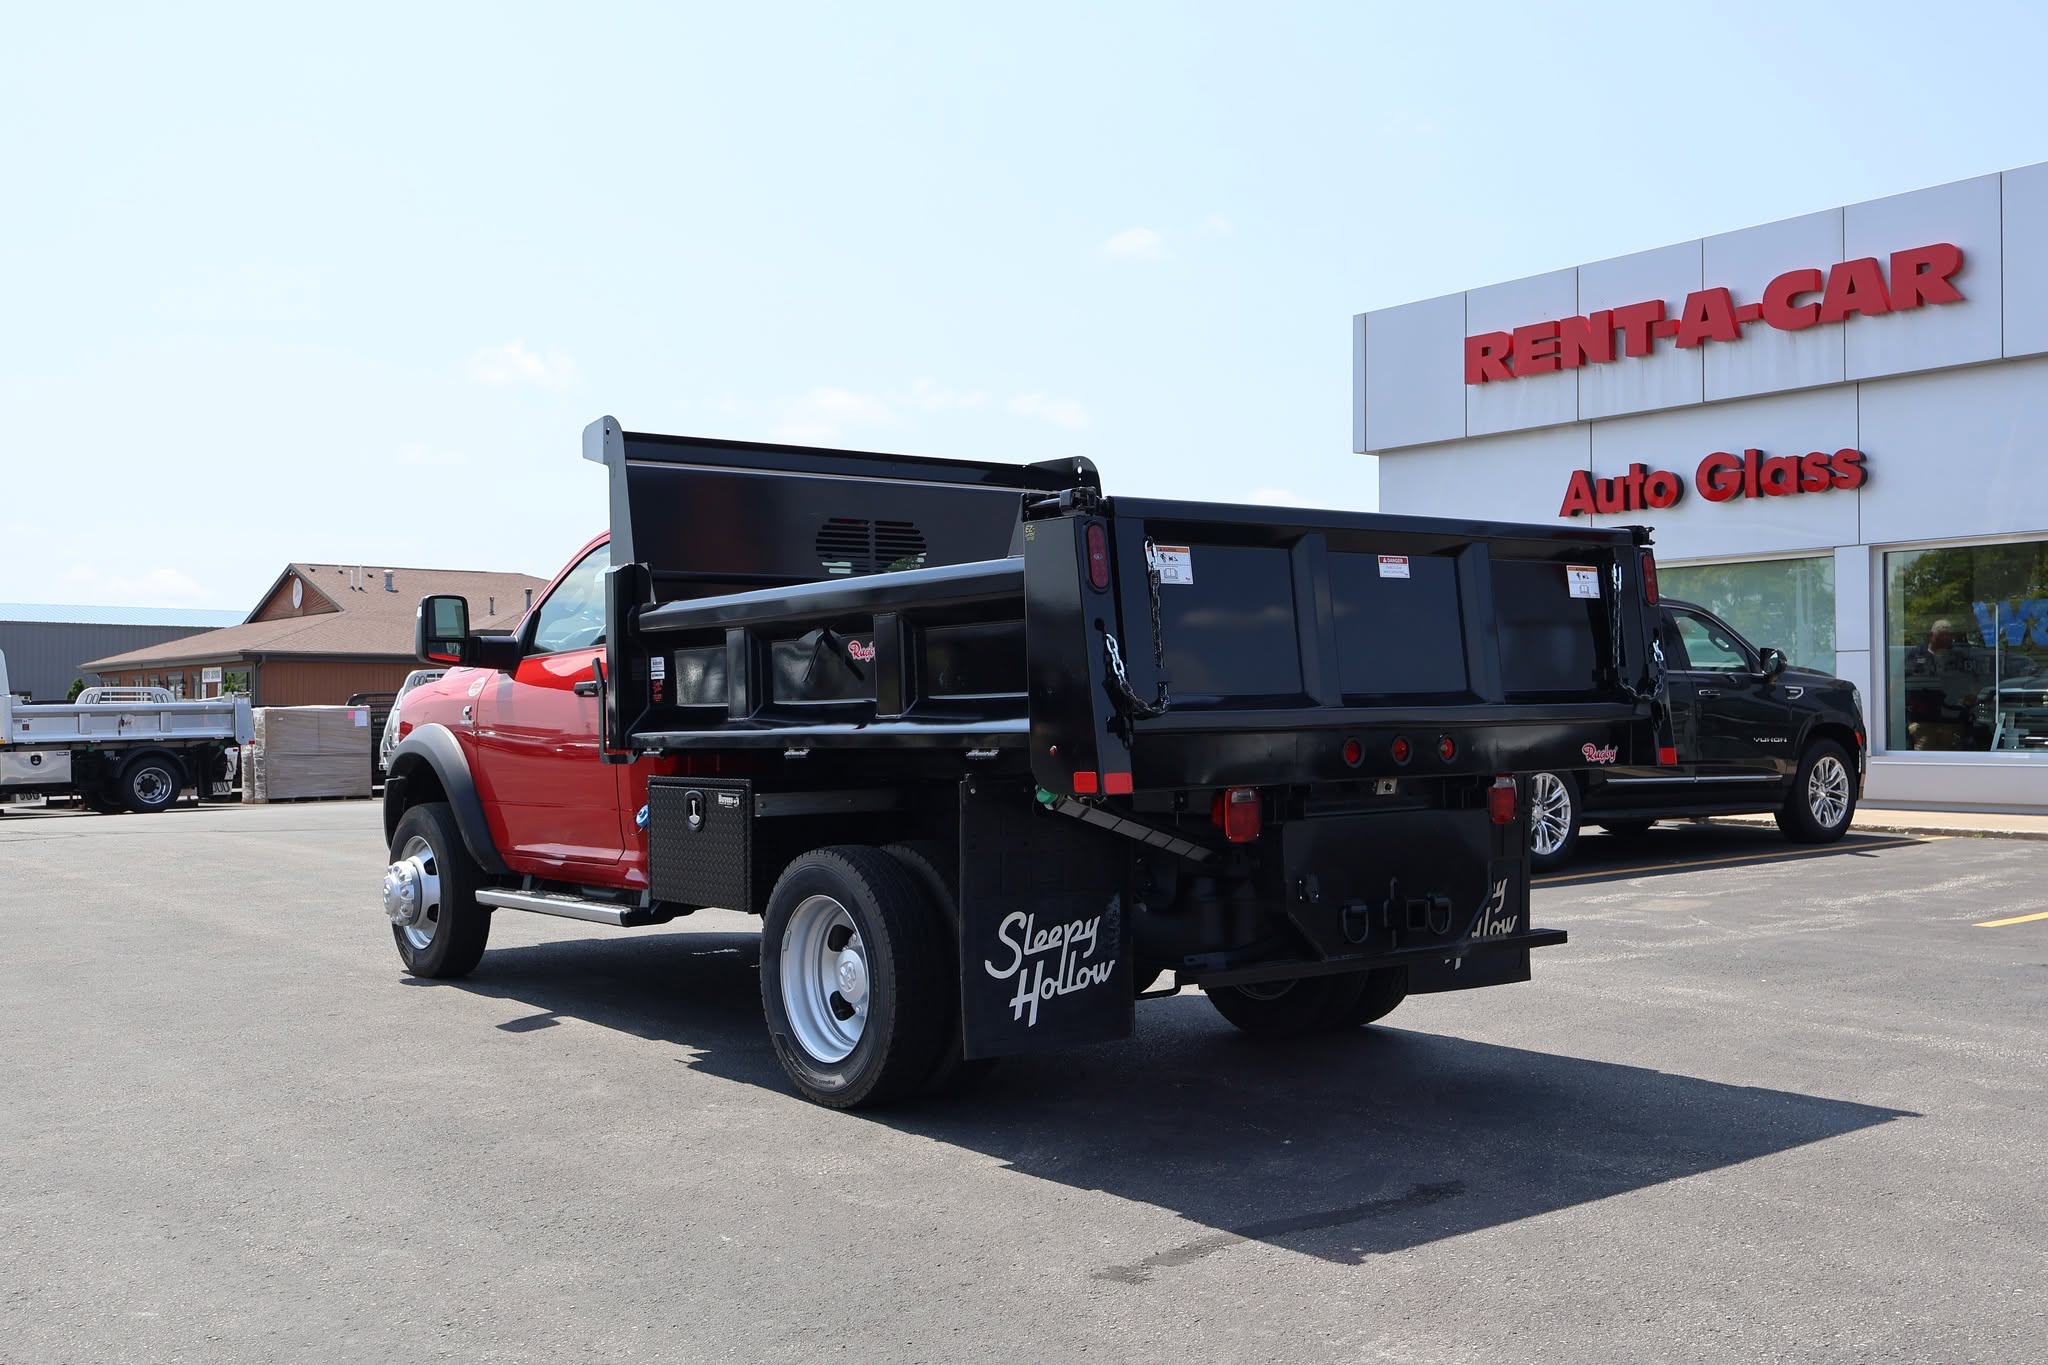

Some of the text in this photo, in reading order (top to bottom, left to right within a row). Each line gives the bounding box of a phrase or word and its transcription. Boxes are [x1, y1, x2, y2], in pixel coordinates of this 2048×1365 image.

[1464, 242, 1967, 385] RENT-A-CAR
[1558, 448, 1868, 517] Auto Glass
[1581, 743, 1619, 764] Rugby
[984, 911, 1101, 980] Sleepy
[1009, 950, 1116, 1027] Hollow
